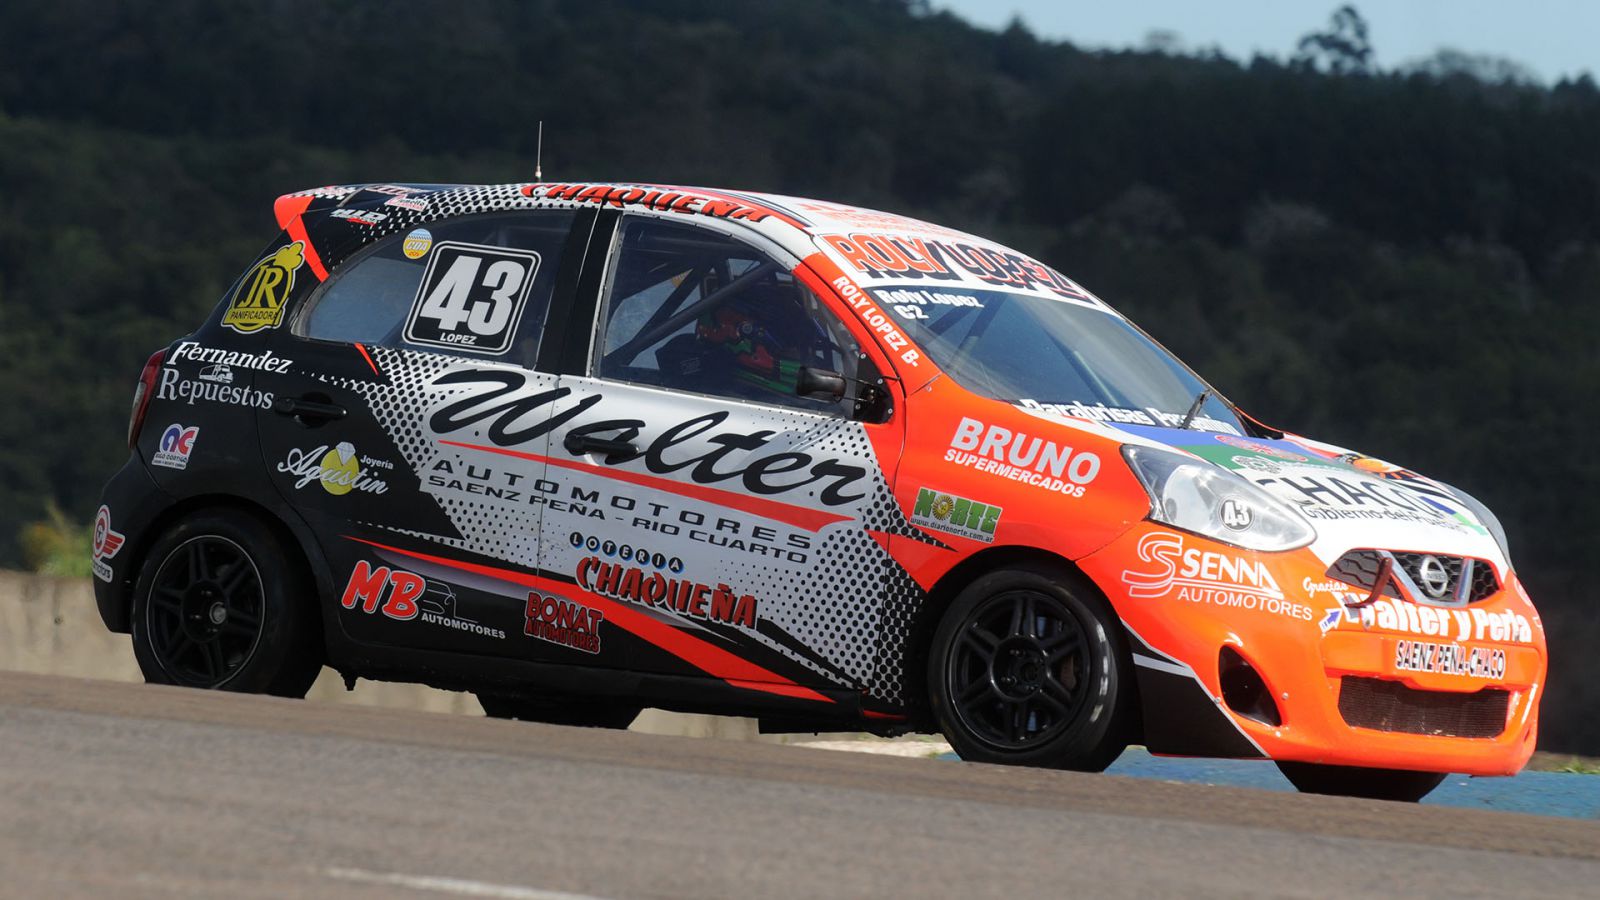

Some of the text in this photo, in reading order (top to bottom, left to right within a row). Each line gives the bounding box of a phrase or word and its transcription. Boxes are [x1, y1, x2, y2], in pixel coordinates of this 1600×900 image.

[821, 233, 955, 277] ROLY
[237, 265, 279, 307] JR
[419, 255, 526, 335] 43
[873, 289, 985, 308] Roly Lopez
[230, 310, 279, 320] PANIFICADORA
[833, 276, 871, 309] ROLY
[862, 307, 909, 351] LOPEZ
[893, 304, 929, 319] C2
[166, 341, 293, 374] Fernandez
[439, 332, 477, 345] LOPEZ
[156, 368, 274, 409] Repuestos
[1019, 399, 1155, 426] Parabrisas
[430, 369, 867, 506] Walter
[950, 416, 1101, 485] BRUNO
[277, 445, 389, 495] Agustin
[944, 449, 1086, 498] SUPERMERCADOS
[428, 475, 521, 502] SAENZ
[528, 494, 606, 521] PEÑA
[632, 518, 679, 536] RIO
[688, 531, 808, 564] CUARTO
[432, 459, 811, 549] AUTOMOTORES
[914, 488, 1002, 534] NORTE
[1223, 500, 1252, 528] 43
[910, 517, 994, 543] www.diarionorte.com.ar
[570, 532, 683, 573] LOTERIA
[1180, 549, 1282, 595] SENNA
[341, 560, 425, 620] MB
[1178, 587, 1313, 621] AUTOMOTORES
[1303, 577, 1349, 598] Gracias
[421, 612, 506, 639] AUTOMOTORES
[526, 592, 603, 634] BONAT
[1455, 609, 1472, 641] y
[1471, 608, 1532, 643] Perla
[524, 618, 600, 654] AUTOMOTORES
[1396, 641, 1435, 671] SAENZ
